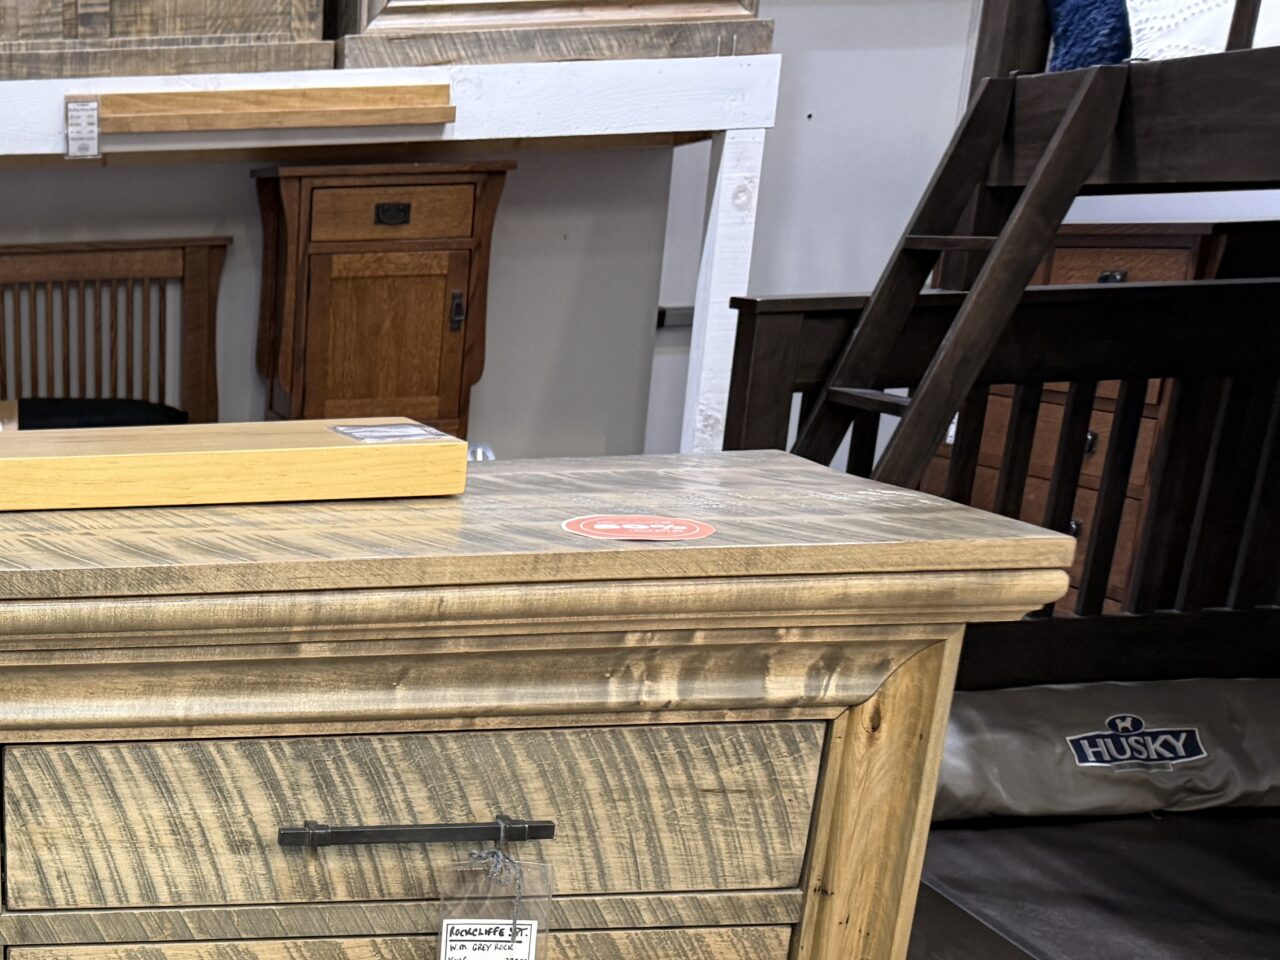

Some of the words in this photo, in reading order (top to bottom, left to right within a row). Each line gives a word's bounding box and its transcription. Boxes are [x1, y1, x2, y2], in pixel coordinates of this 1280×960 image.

[1080, 733, 1187, 761] HUSKY
[449, 926, 505, 938] ROCKCLIFFE
[473, 943, 494, 952] GREY
[495, 943, 514, 951] ROCK
